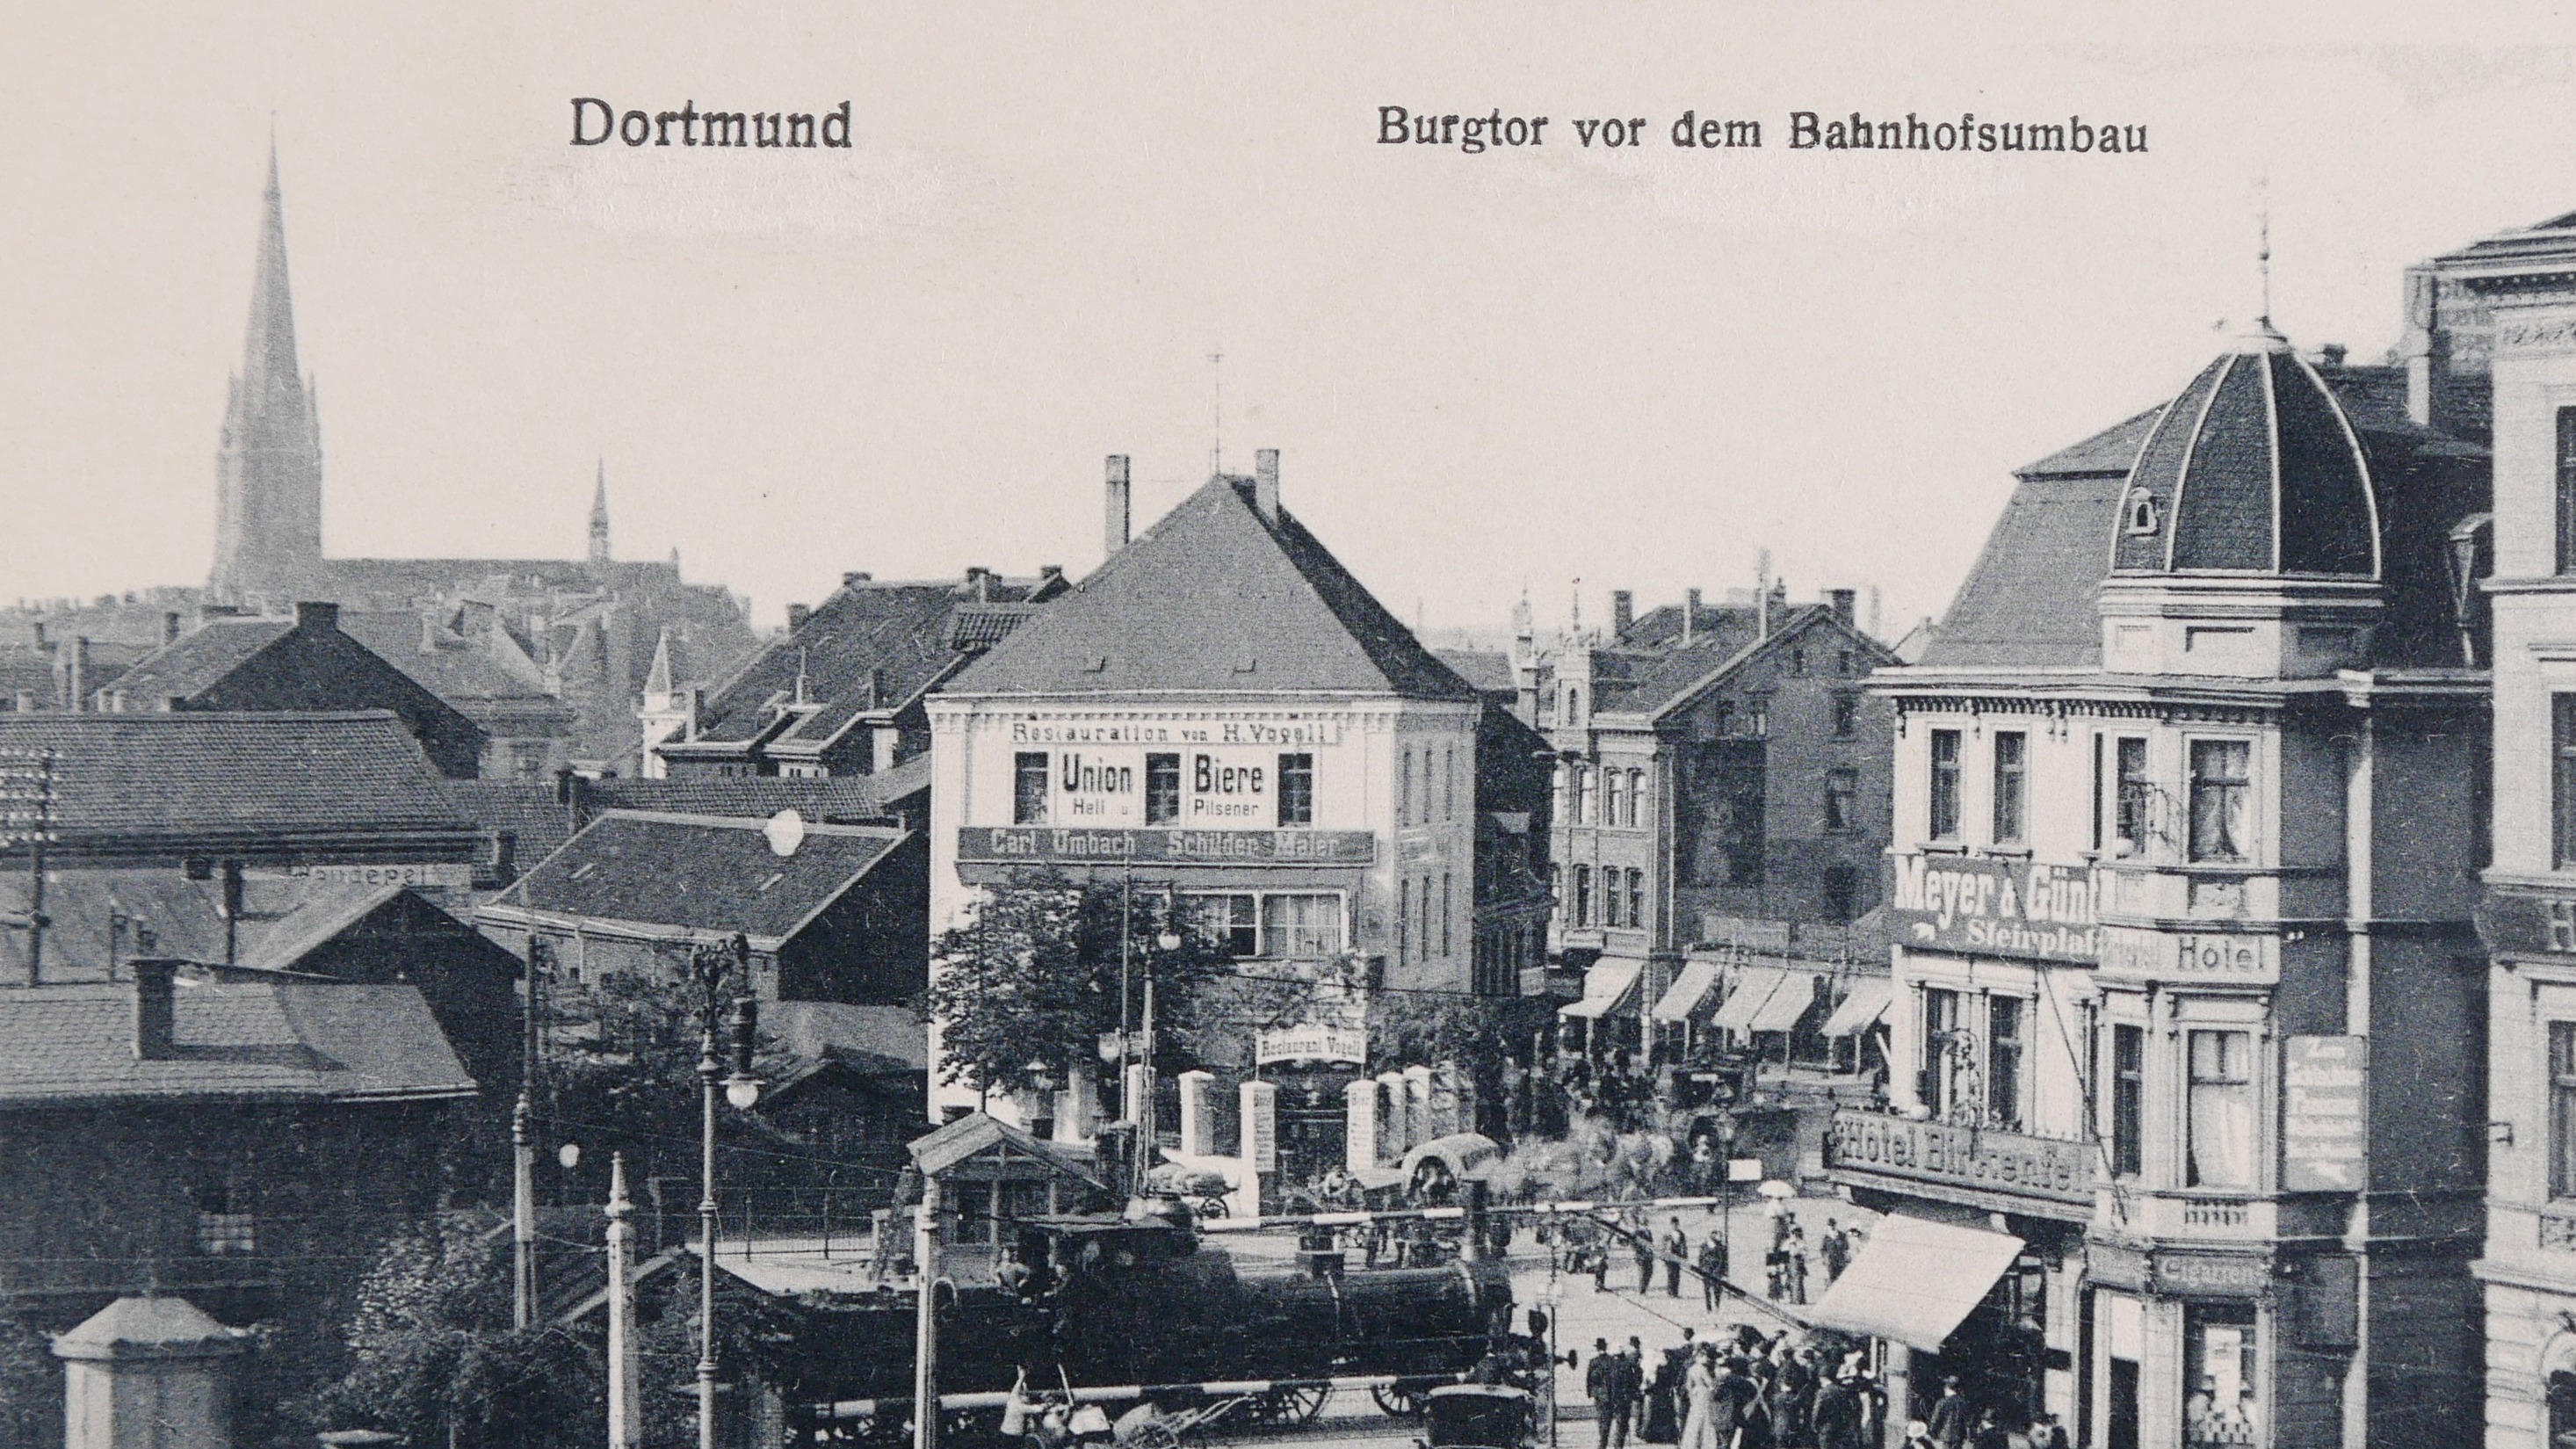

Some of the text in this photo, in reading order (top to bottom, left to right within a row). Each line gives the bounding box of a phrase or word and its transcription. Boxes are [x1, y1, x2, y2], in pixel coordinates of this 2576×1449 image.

[1062, 753, 1263, 793] Union Biere
[1073, 798, 1105, 815] Hell
[1194, 798, 1259, 816] Pilsener
[991, 829, 1036, 854] Carl
[1893, 854, 1995, 930] Meyer
